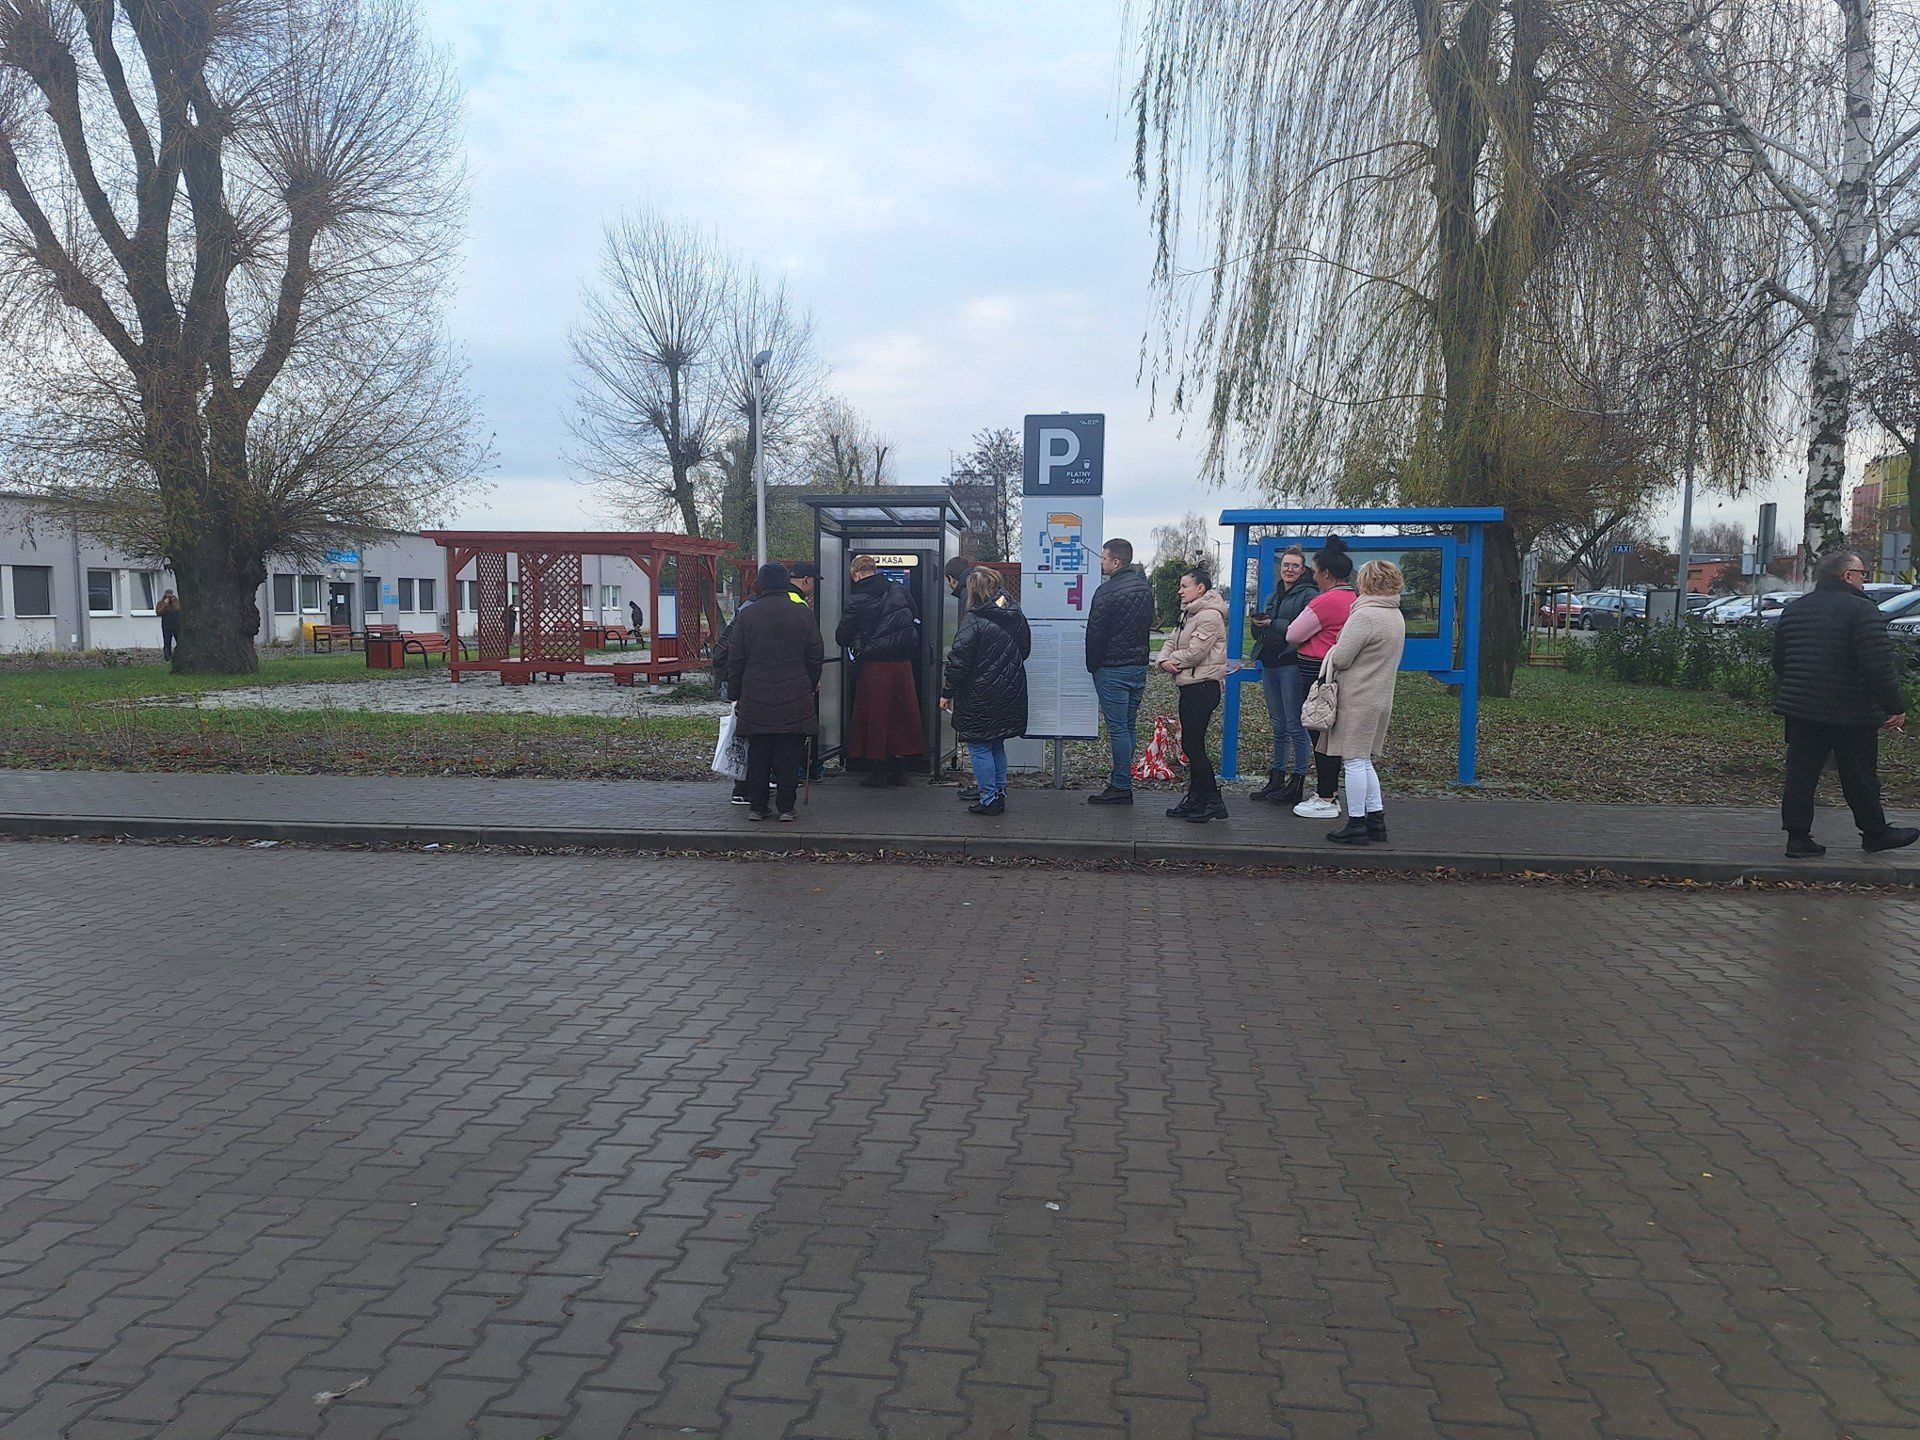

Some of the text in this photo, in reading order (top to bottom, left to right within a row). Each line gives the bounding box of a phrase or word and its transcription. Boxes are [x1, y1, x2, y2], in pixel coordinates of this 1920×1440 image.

[1038, 428, 1080, 485] P
[1613, 545, 1632, 553] TAXI
[881, 556, 903, 565] KASA
